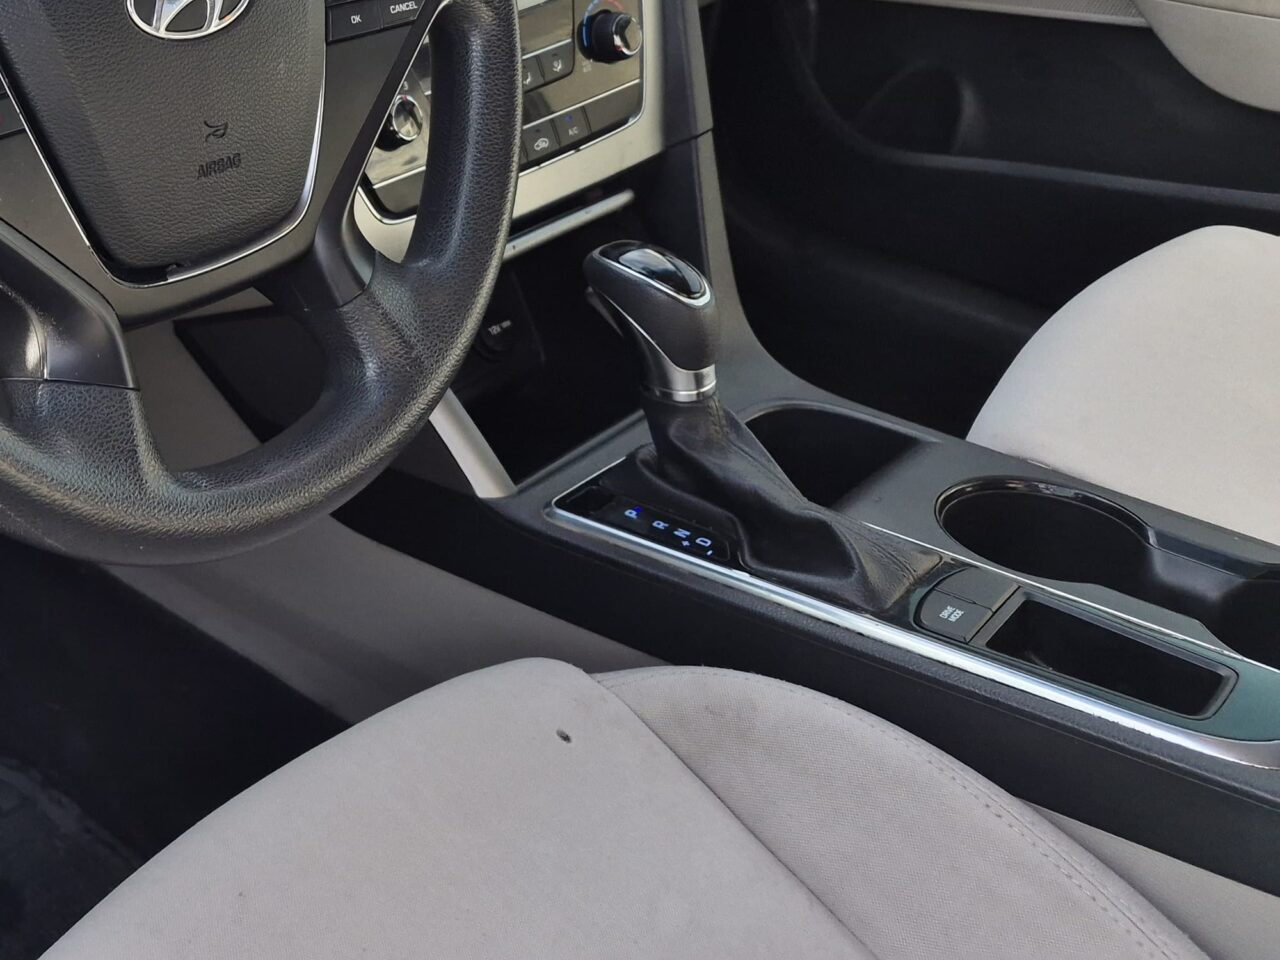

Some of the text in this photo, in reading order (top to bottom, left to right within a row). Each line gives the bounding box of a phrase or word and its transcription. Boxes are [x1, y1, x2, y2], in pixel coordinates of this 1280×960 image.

[390, 0, 418, 14] CANCEL
[350, 14, 363, 25] OK
[197, 152, 242, 180] AIRBAG
[624, 508, 640, 520] P
[652, 520, 670, 530] R
[673, 528, 691, 538] N
[695, 537, 712, 547] D
